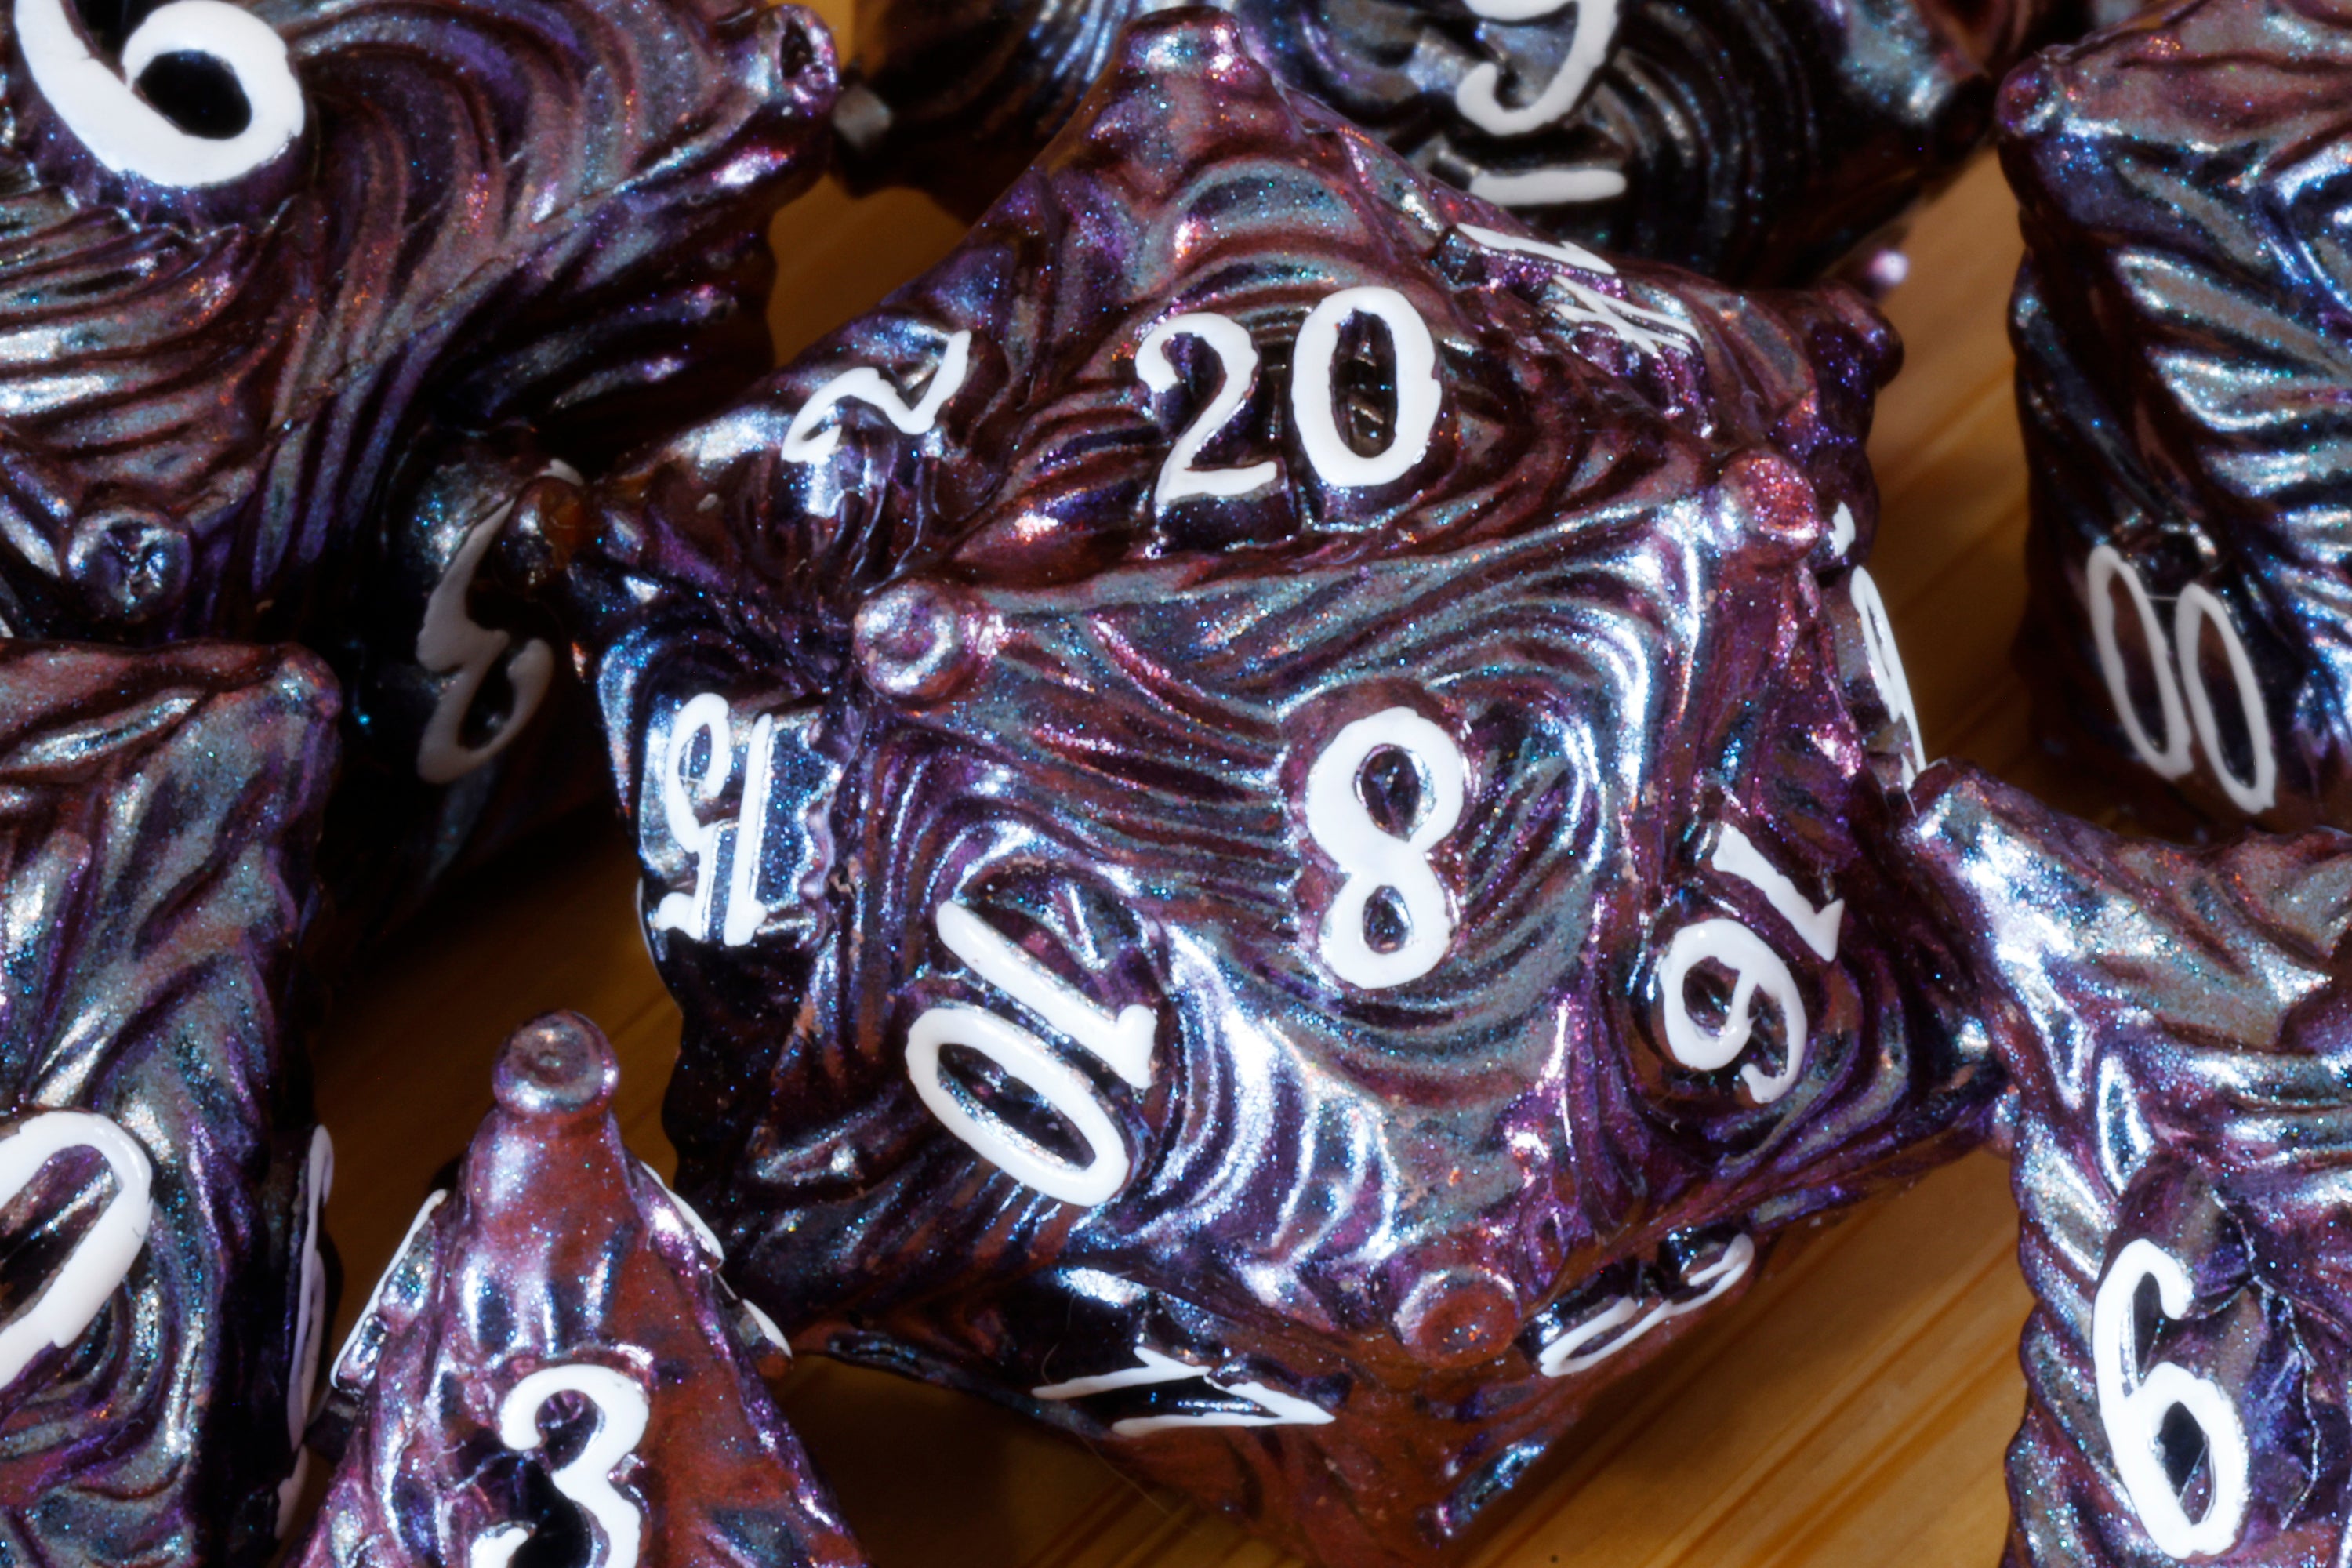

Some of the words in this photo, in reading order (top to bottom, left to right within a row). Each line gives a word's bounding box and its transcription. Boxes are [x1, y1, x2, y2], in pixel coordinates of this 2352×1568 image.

[14, 0, 305, 187] 6
[782, 329, 971, 463] 2
[1134, 286, 1442, 506] 20
[2087, 545, 2276, 815] 00
[655, 692, 768, 947] 15
[1305, 706, 1465, 990] 8
[905, 899, 1158, 1208] 10
[1658, 822, 1844, 1105] 16
[470, 1363, 650, 1568] 3
[2092, 1237, 2250, 1559] 6
